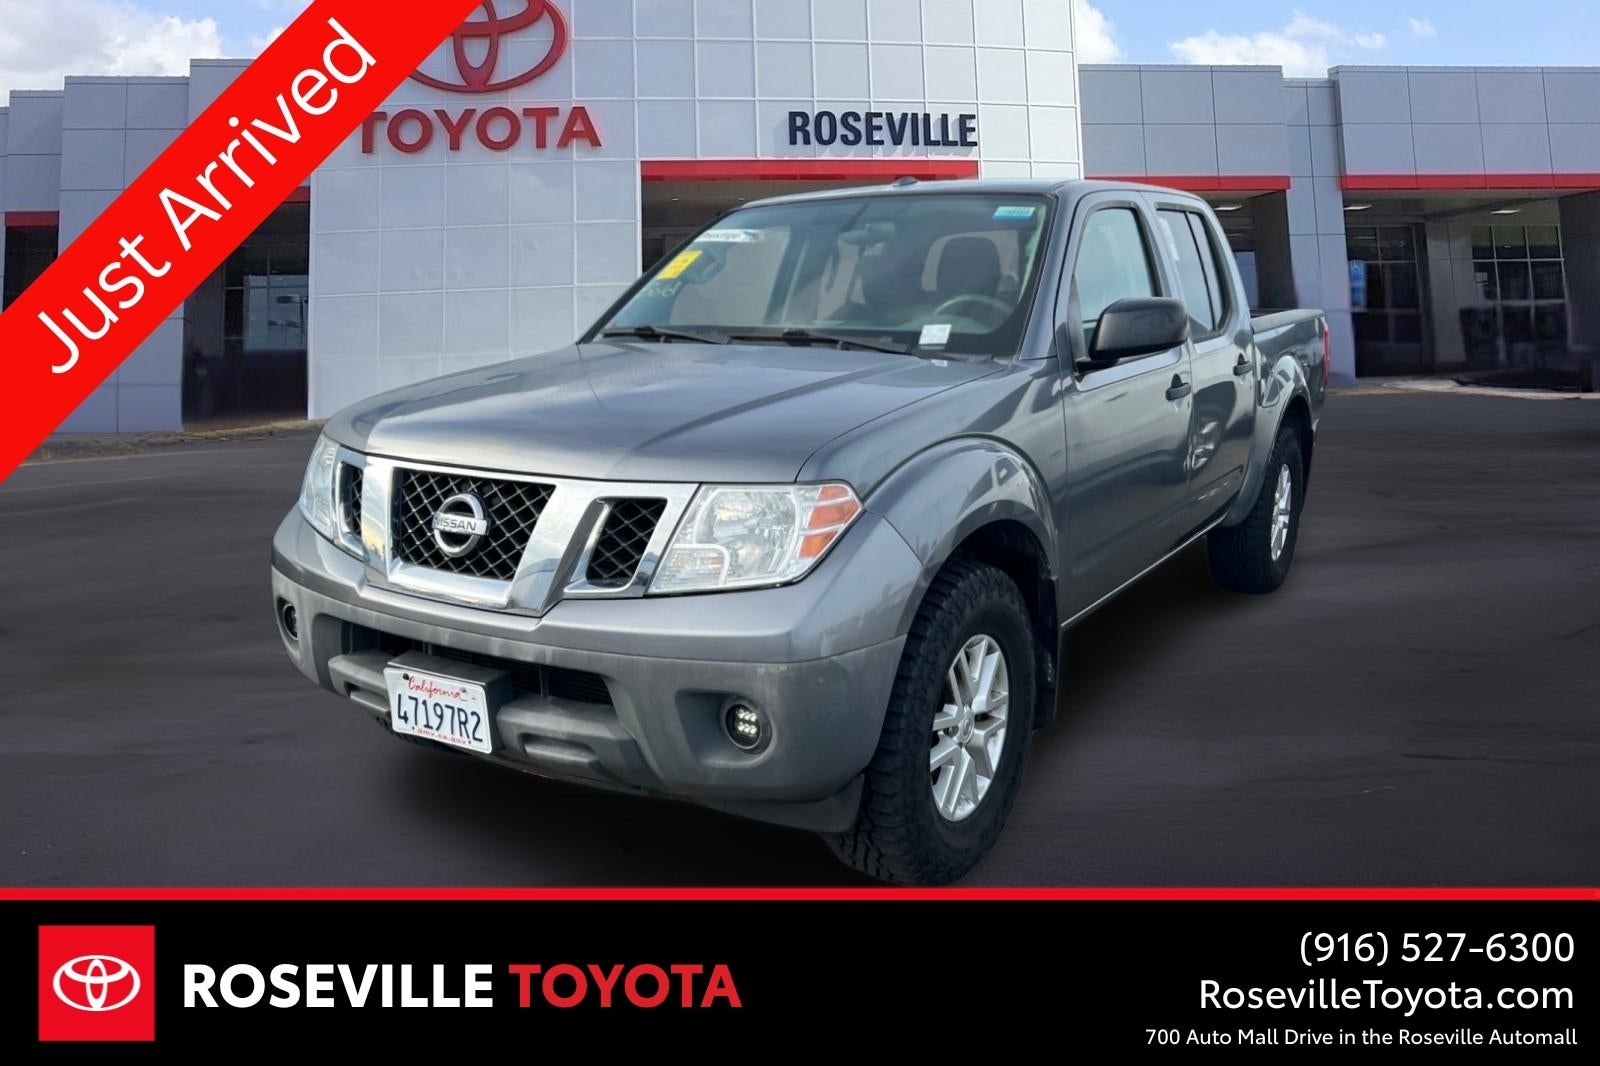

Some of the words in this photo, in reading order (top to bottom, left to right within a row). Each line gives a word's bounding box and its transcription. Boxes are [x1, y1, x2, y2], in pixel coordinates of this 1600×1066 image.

[361, 106, 602, 154] TOYOTA
[788, 110, 978, 147] ROSEVILLE
[434, 515, 477, 532] NISSAN
[408, 675, 468, 702] California
[397, 694, 483, 743] 47197R2
